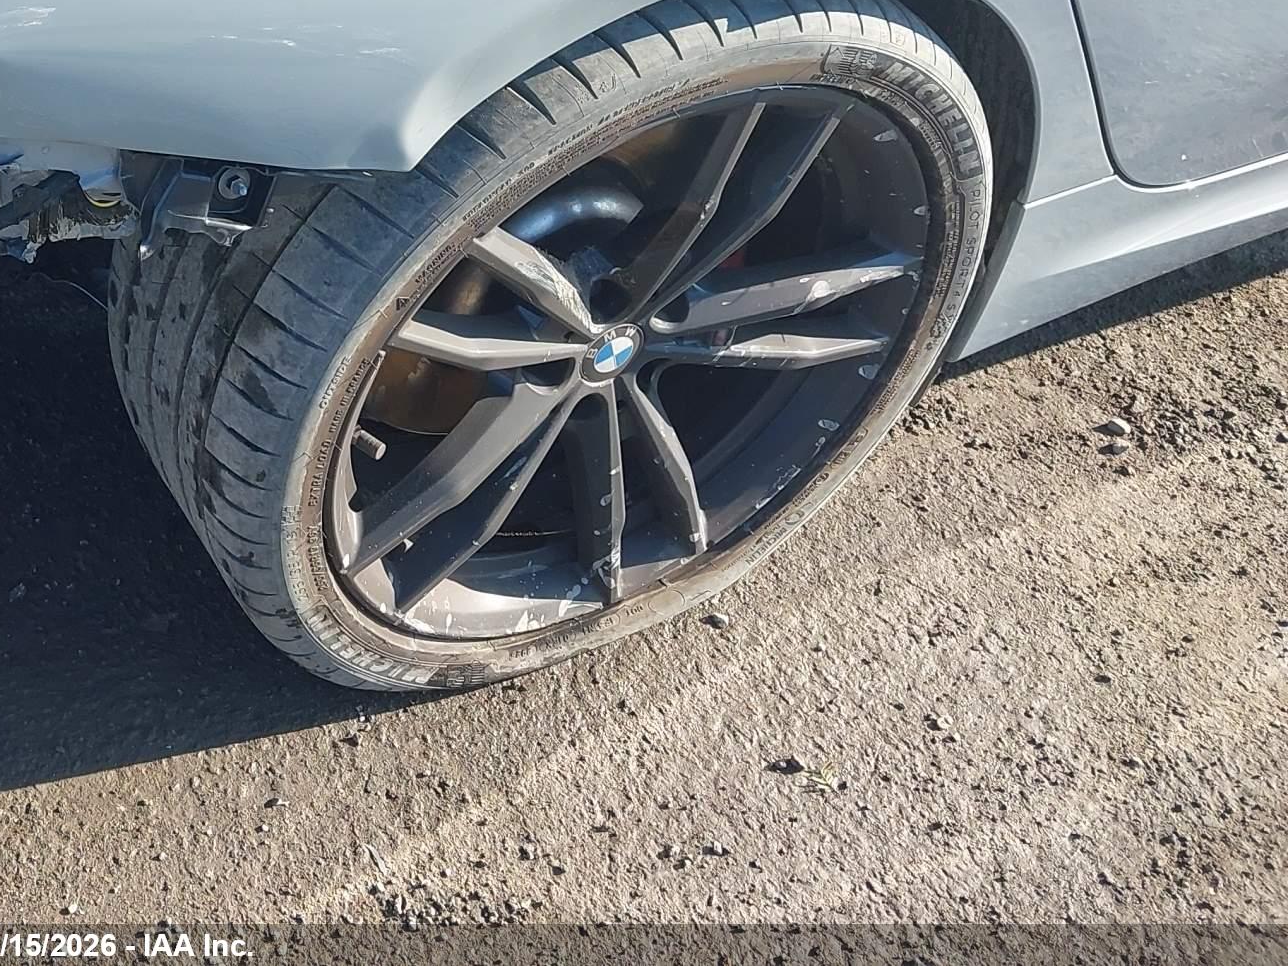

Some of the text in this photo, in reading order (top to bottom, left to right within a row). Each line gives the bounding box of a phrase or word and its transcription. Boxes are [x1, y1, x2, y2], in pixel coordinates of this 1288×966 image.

[880, 61, 981, 177] MICHELIN
[969, 188, 981, 231] PILOT
[957, 236, 977, 290] SPORT
[586, 326, 637, 359] BMW
[745, 527, 788, 564] MICHELIN
[305, 610, 439, 685] MICHELIN
